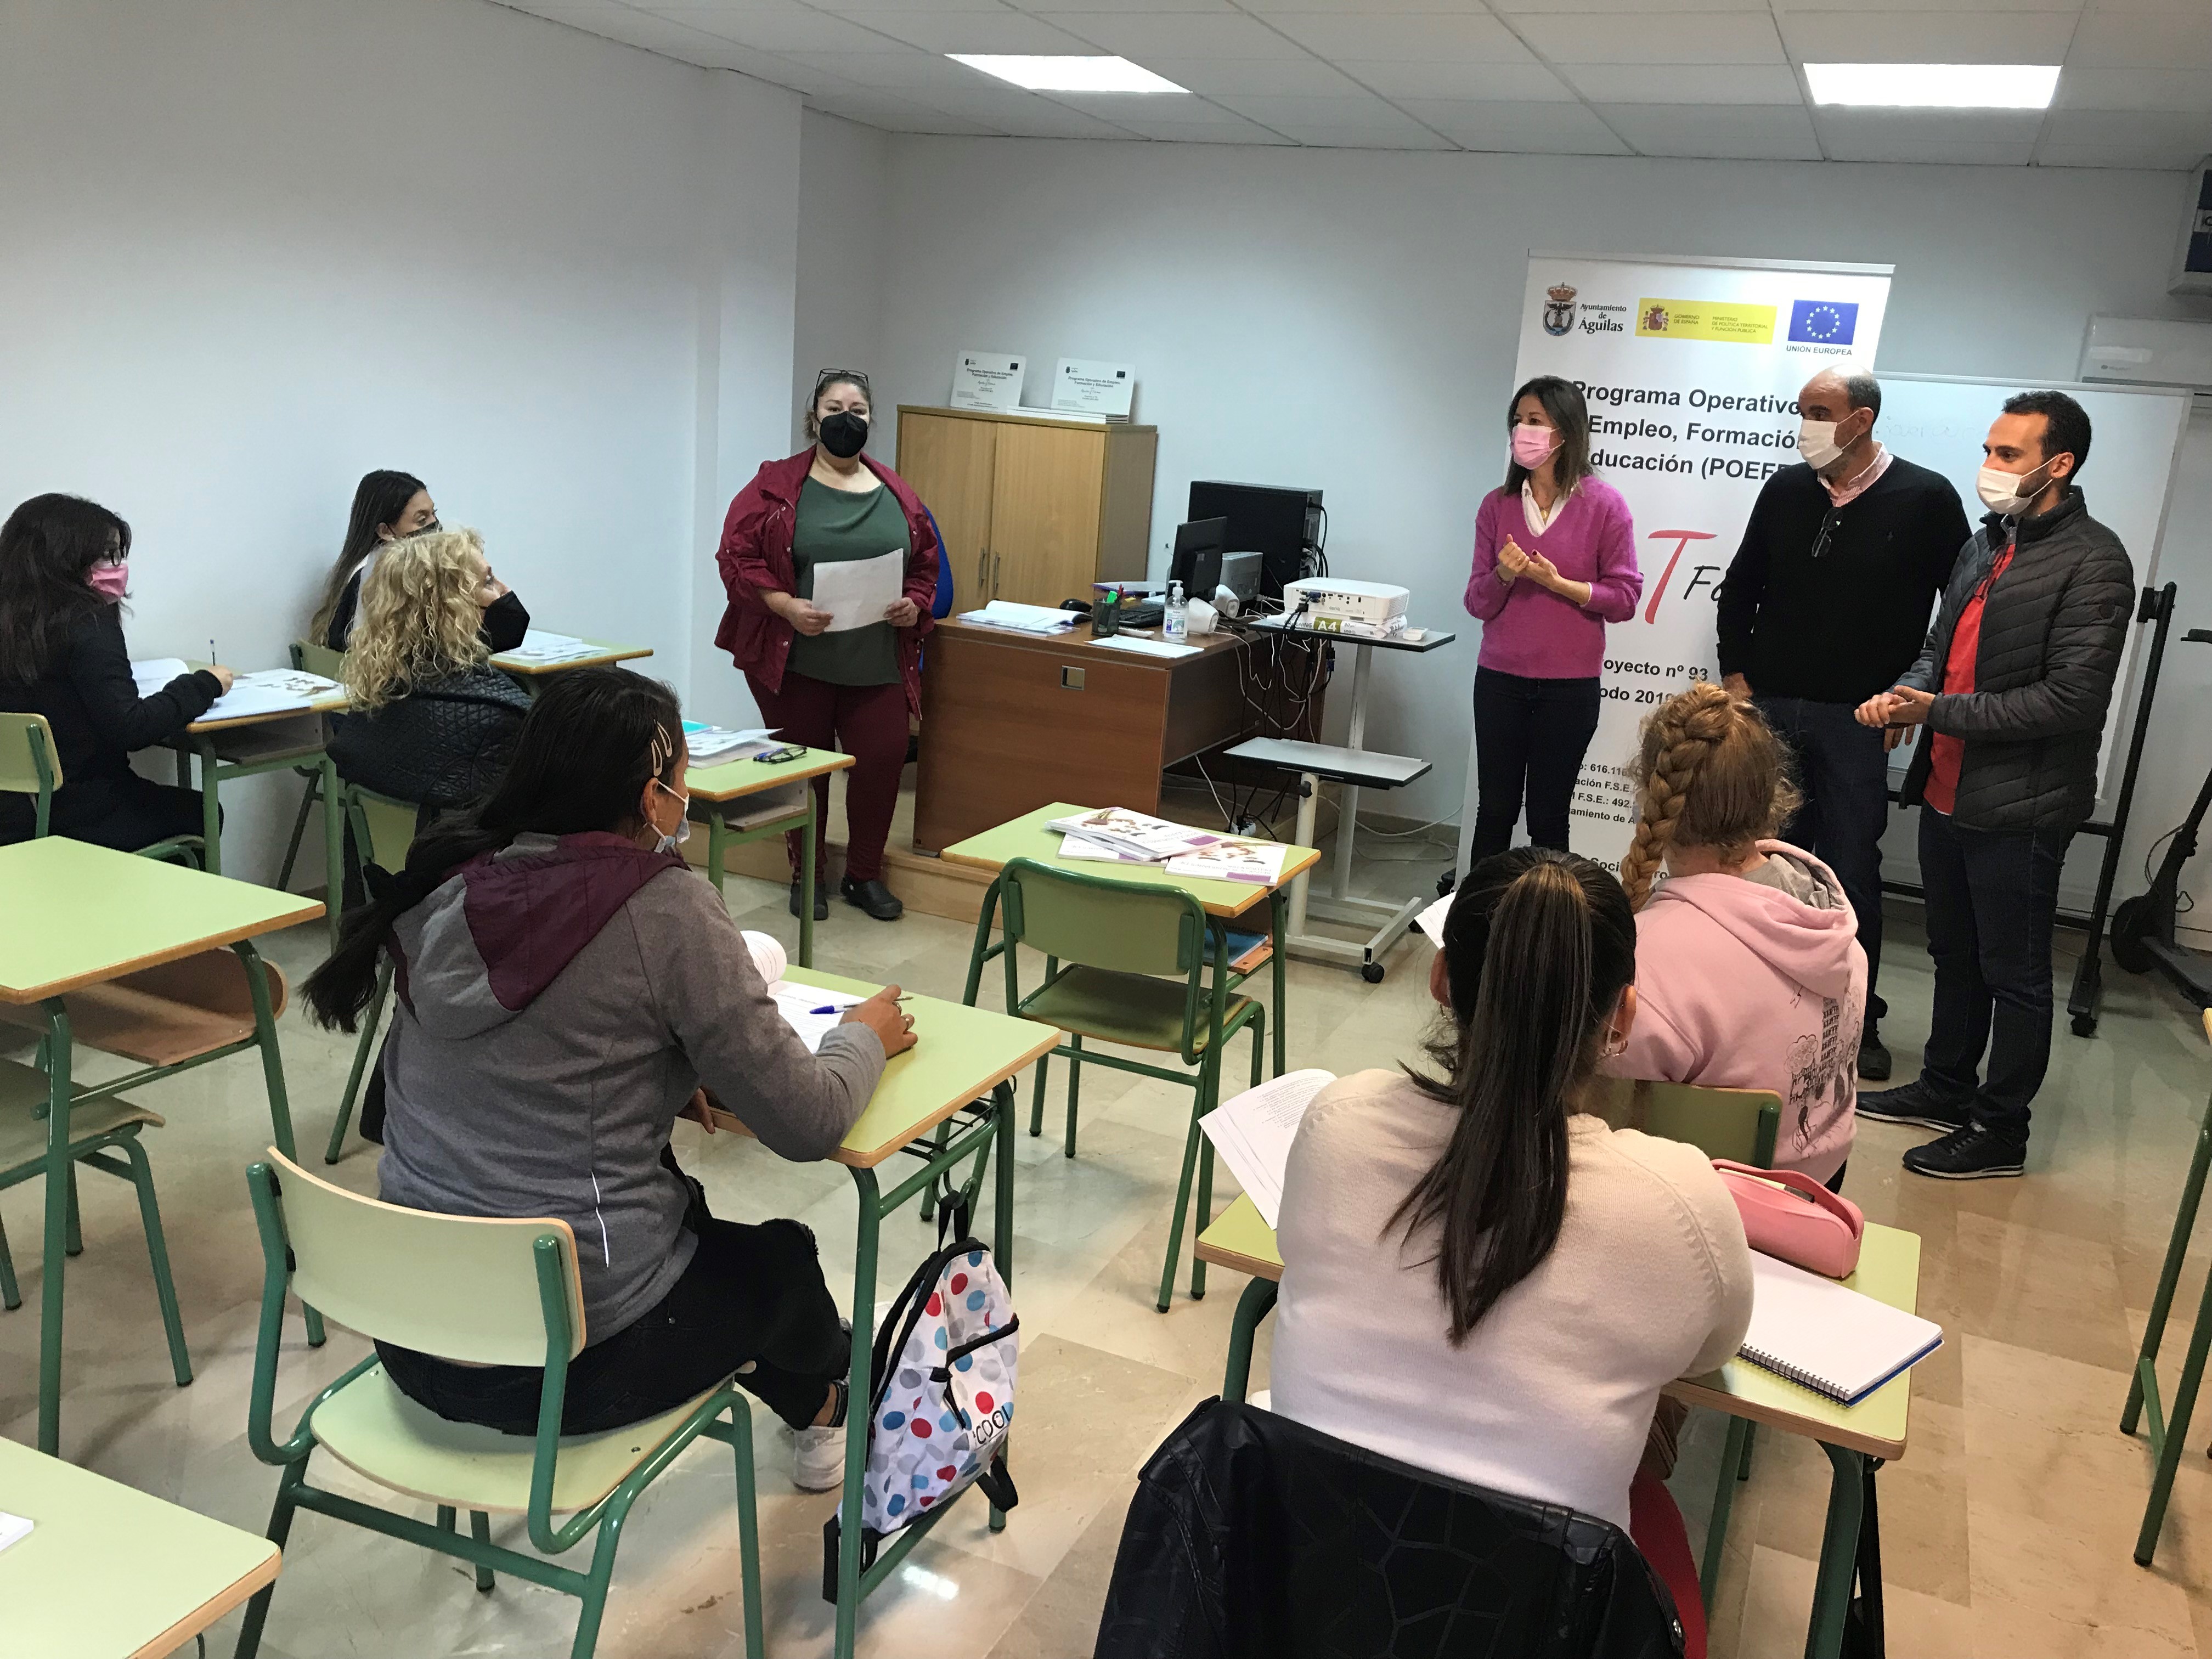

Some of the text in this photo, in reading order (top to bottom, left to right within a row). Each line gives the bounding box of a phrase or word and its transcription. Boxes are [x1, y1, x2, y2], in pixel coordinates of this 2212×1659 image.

[1580, 303, 1627, 312] Ayuntamiento
[1578, 317, 1623, 334] Águilas
[1813, 347, 1852, 356] EUROPEA
[1689, 388, 1802, 415] Operativo
[1589, 415, 1799, 449] Empleo, Formació
[1590, 449, 1693, 473] ducación
[1701, 457, 1792, 480] (POEF
[1683, 565, 1723, 601] Fo
[1318, 620, 1337, 632] A4
[1603, 659, 1660, 675] oyecto
[1688, 666, 1708, 681] 93
[1600, 686, 1630, 701] odo
[1575, 778, 1601, 788] ación
[1611, 798, 1632, 809] 492.
[1570, 808, 1610, 820] amiento
[1613, 814, 1625, 822] de
[1590, 857, 1620, 871] Soci
